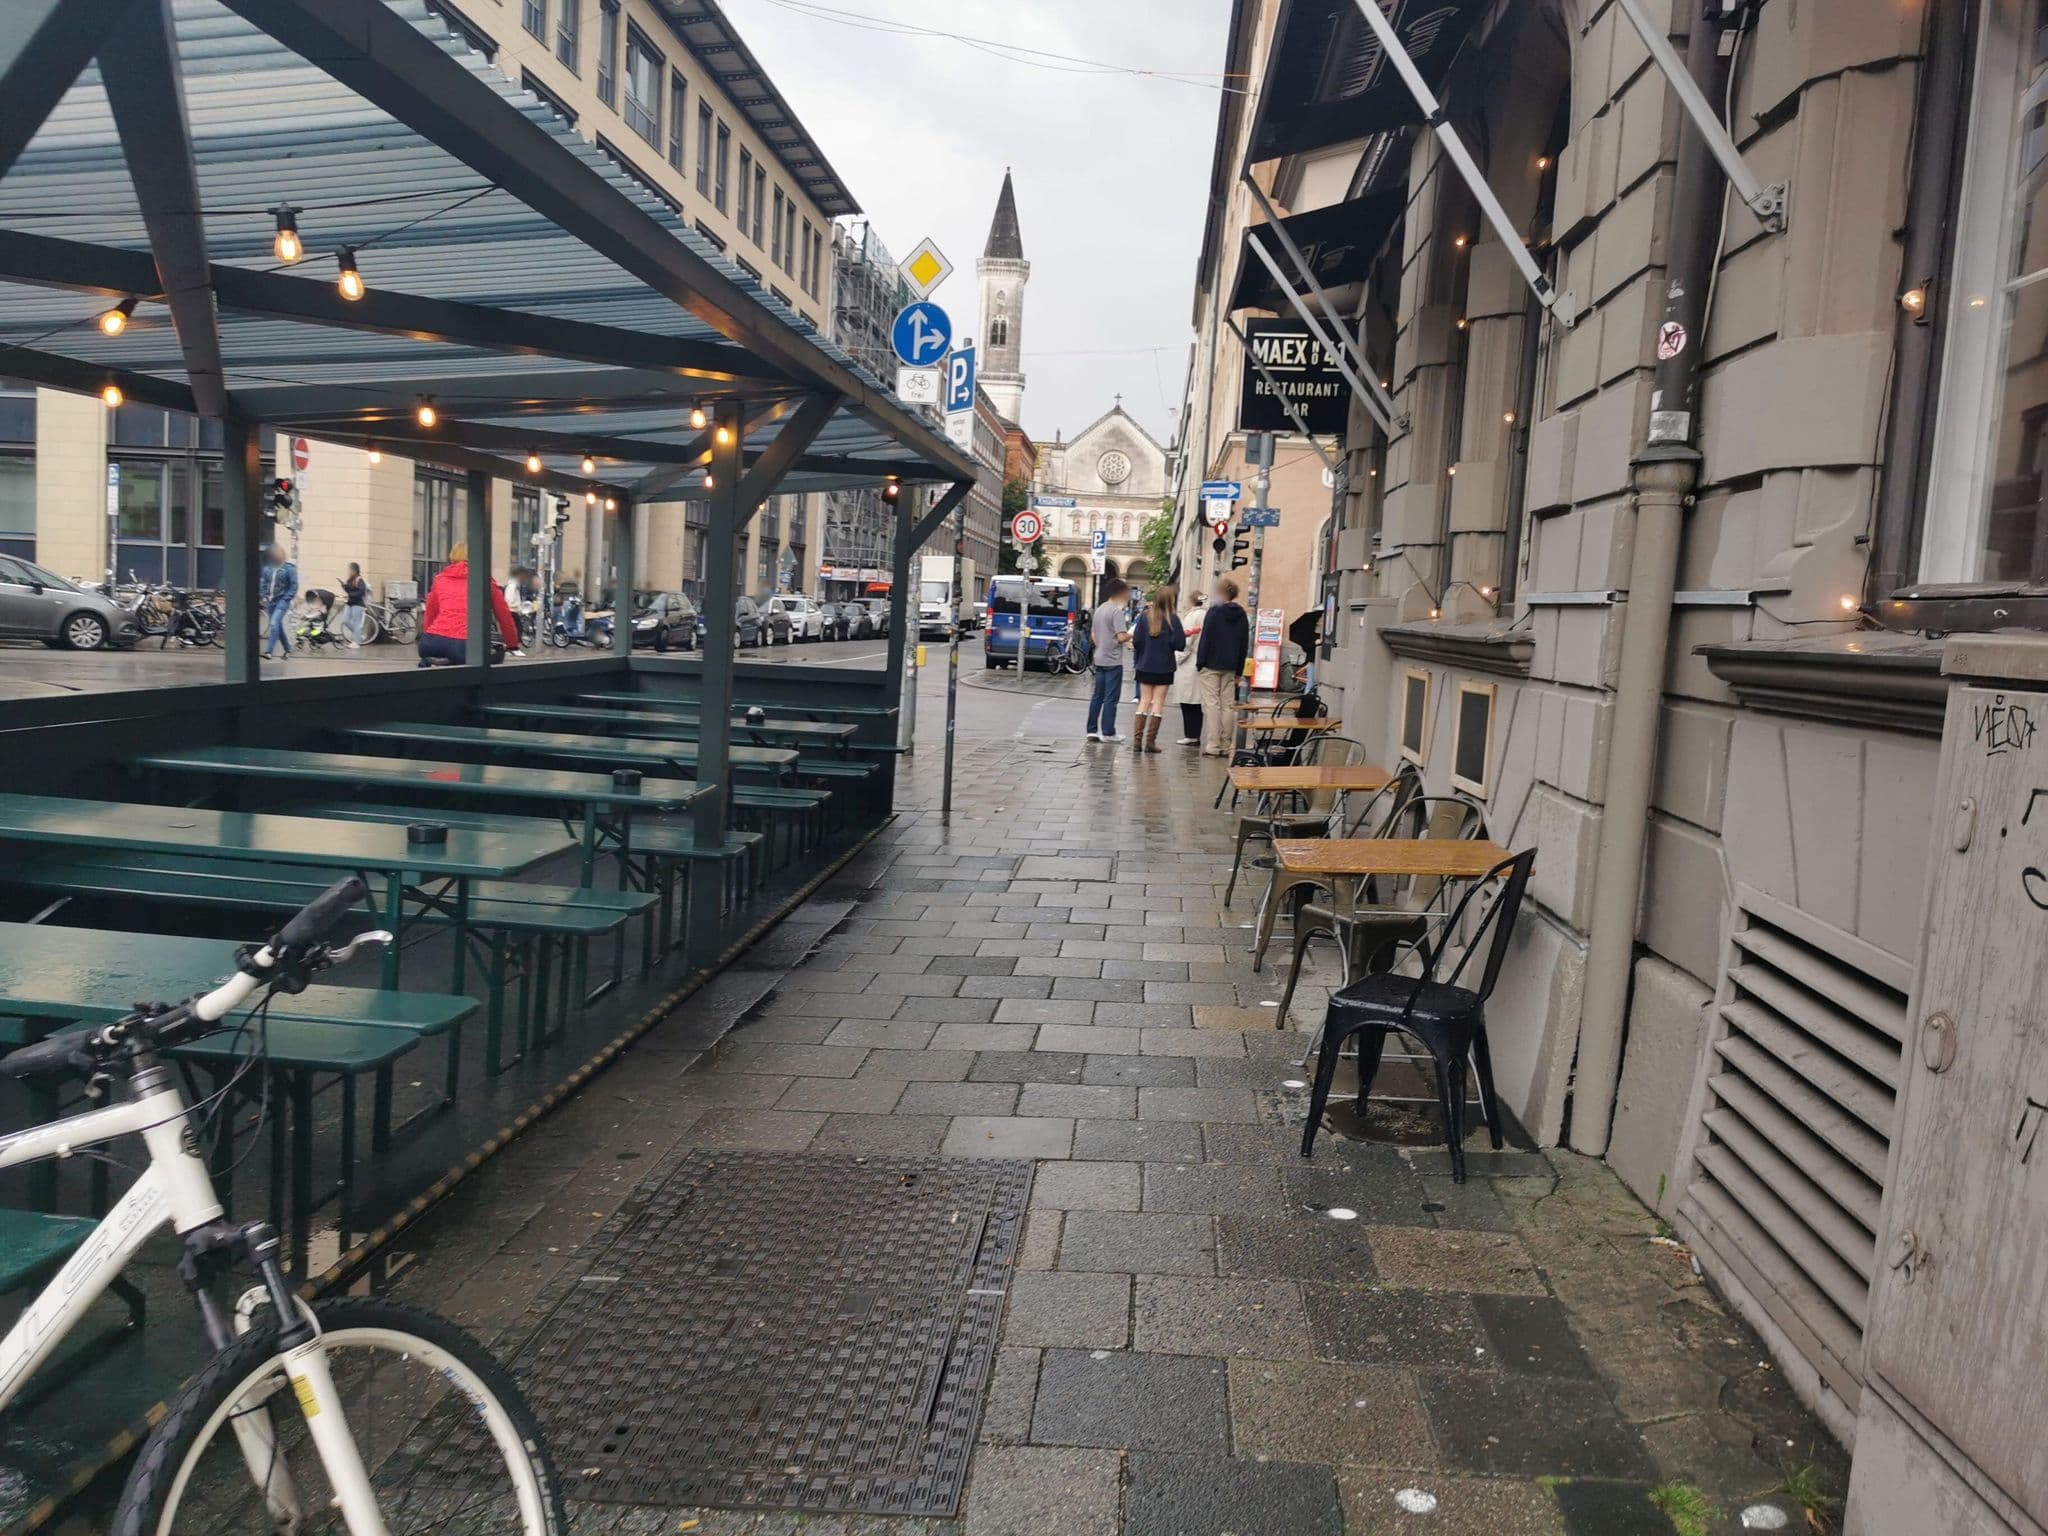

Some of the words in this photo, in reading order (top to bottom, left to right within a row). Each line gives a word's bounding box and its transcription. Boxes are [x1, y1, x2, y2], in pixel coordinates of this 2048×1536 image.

[1252, 338, 1308, 365] MAEX
[951, 357, 968, 405] P
[1255, 379, 1340, 397] RETAURANT
[1018, 519, 1036, 534] 30
[1093, 532, 1103, 547] P
